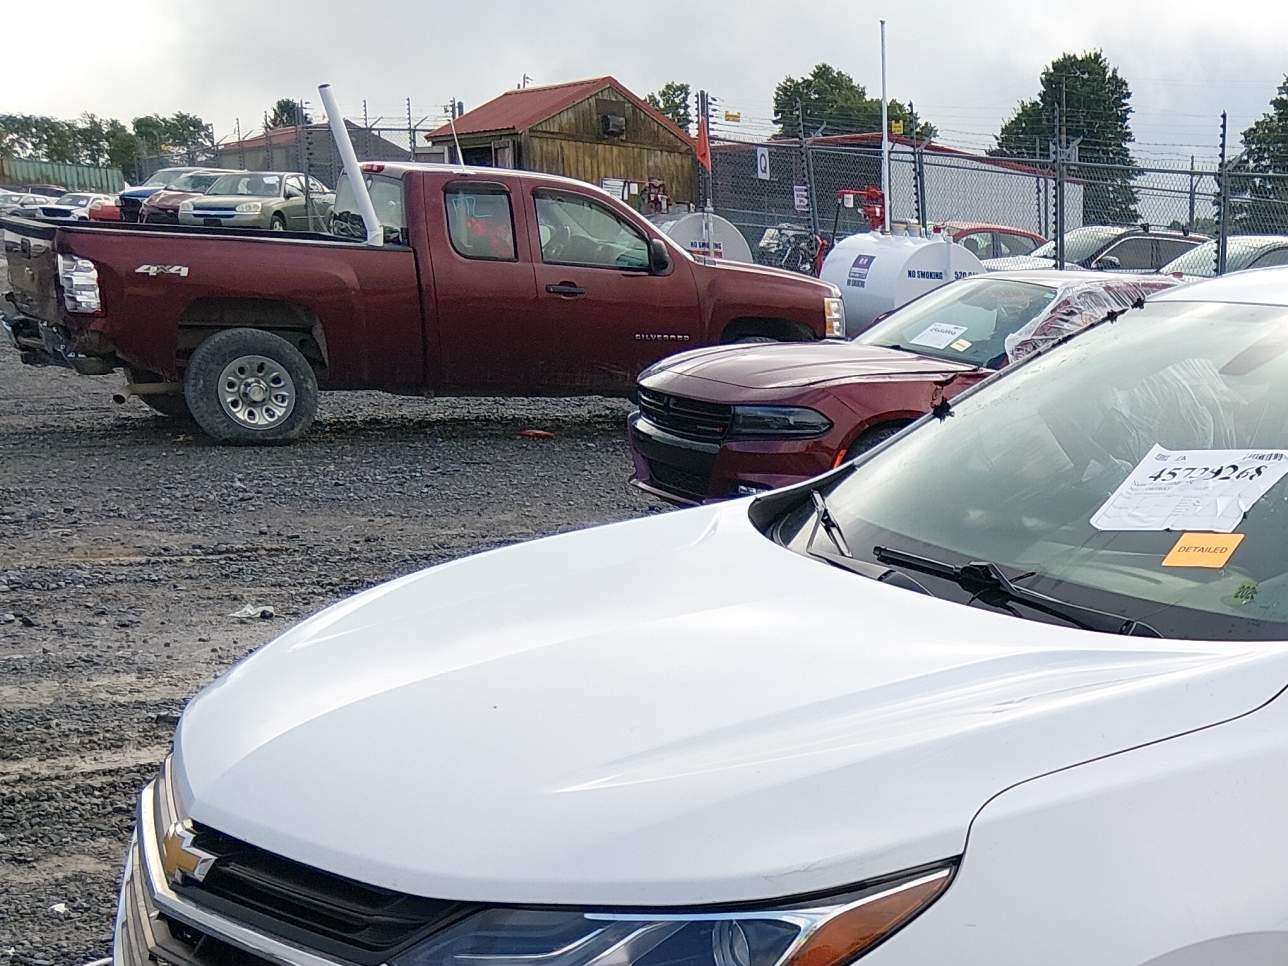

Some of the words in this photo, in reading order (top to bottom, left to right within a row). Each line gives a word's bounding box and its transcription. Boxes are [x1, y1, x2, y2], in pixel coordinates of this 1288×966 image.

[760, 153, 768, 174] Q
[907, 270, 915, 278] NO
[916, 270, 943, 280] SMOKING
[1177, 546, 1229, 554] DETAILED
